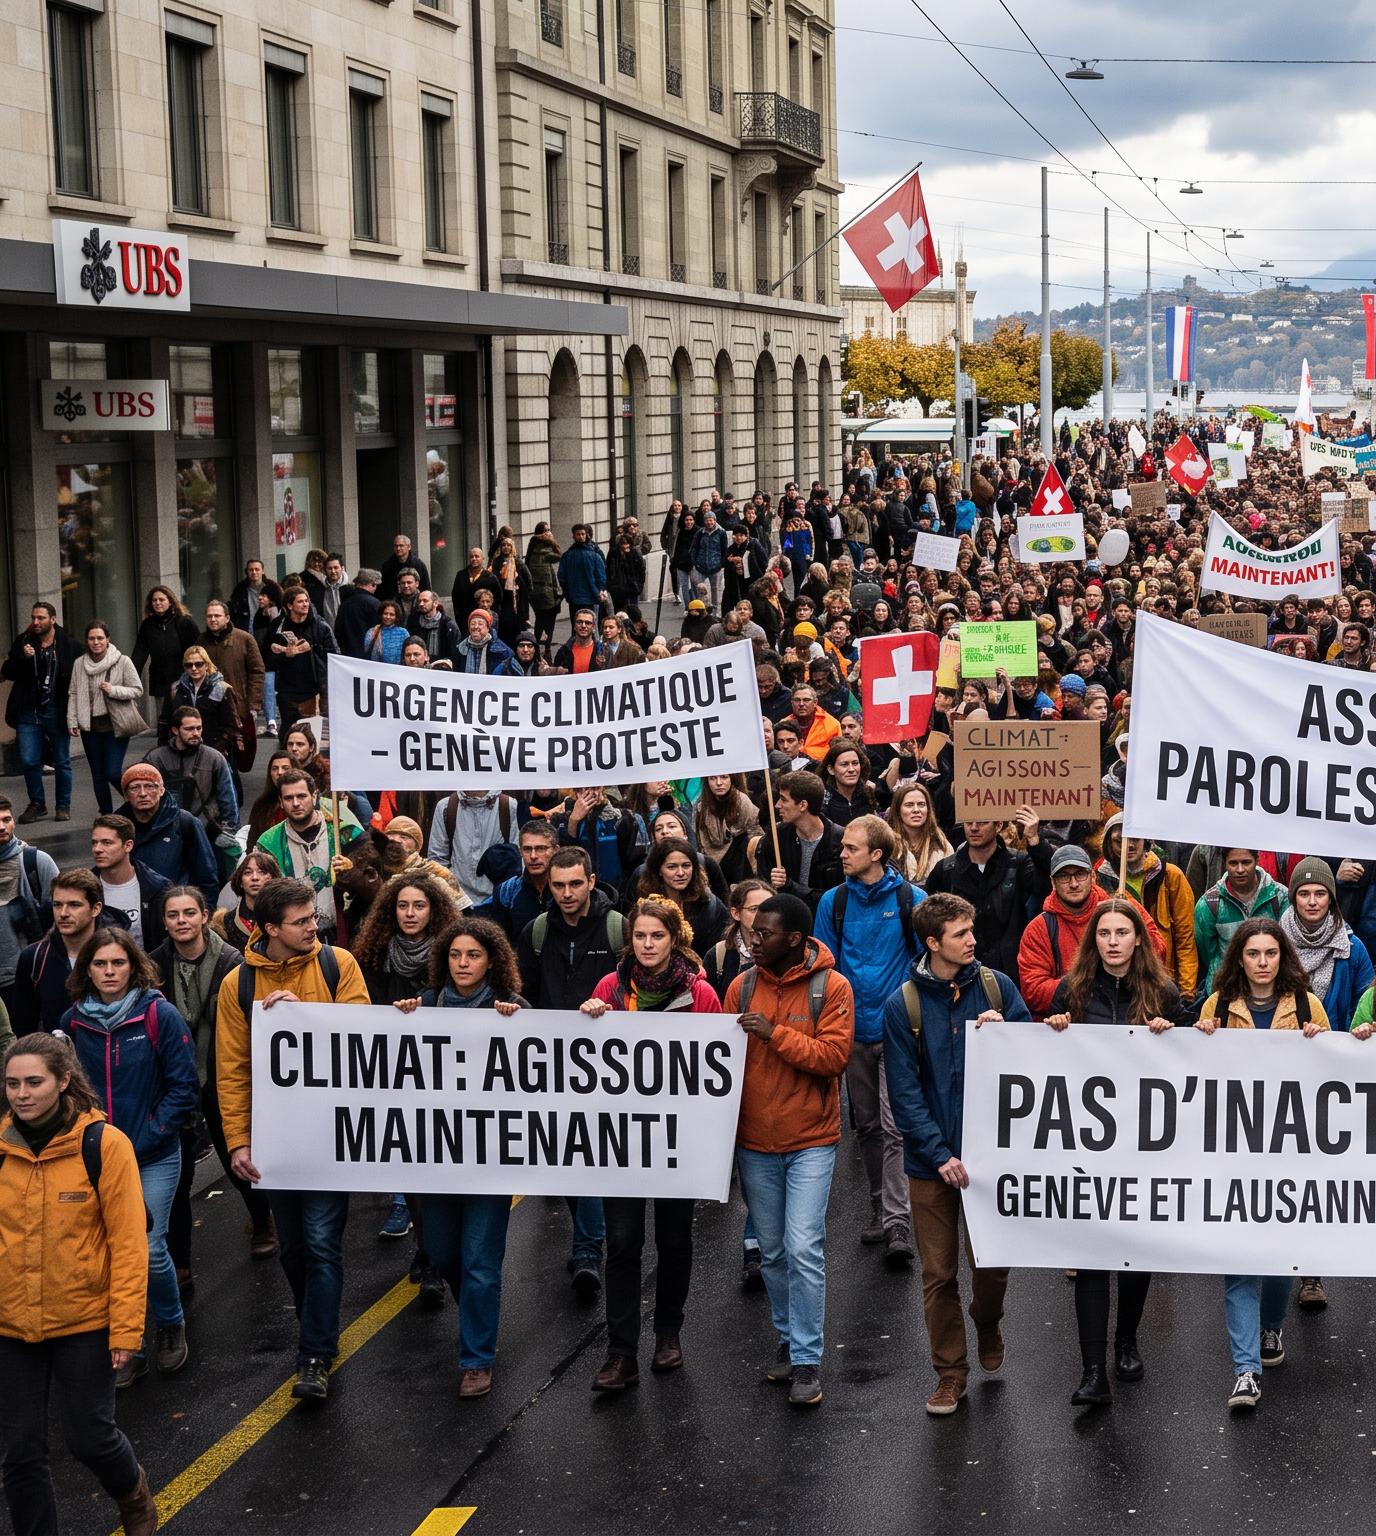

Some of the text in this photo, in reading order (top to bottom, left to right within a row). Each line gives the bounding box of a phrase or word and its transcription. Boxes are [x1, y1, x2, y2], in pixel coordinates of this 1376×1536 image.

[118, 241, 182, 297] UBS
[93, 391, 155, 418] UBS
[1210, 557, 1335, 586] MAINTENANT!
[354, 663, 736, 727] URGENCE CLIMATIQUE
[400, 727, 536, 773] GENÈVE
[548, 716, 724, 773] PROTESTE
[964, 784, 1094, 807] MAINTENANT
[271, 1031, 732, 1097] CLIMAT: AGISSONS
[335, 1107, 677, 1169] MAINTENANT!
[998, 1074, 1116, 1151] PAS
[997, 1167, 1138, 1221] GENÈVE
[1151, 1178, 1192, 1222] ET
